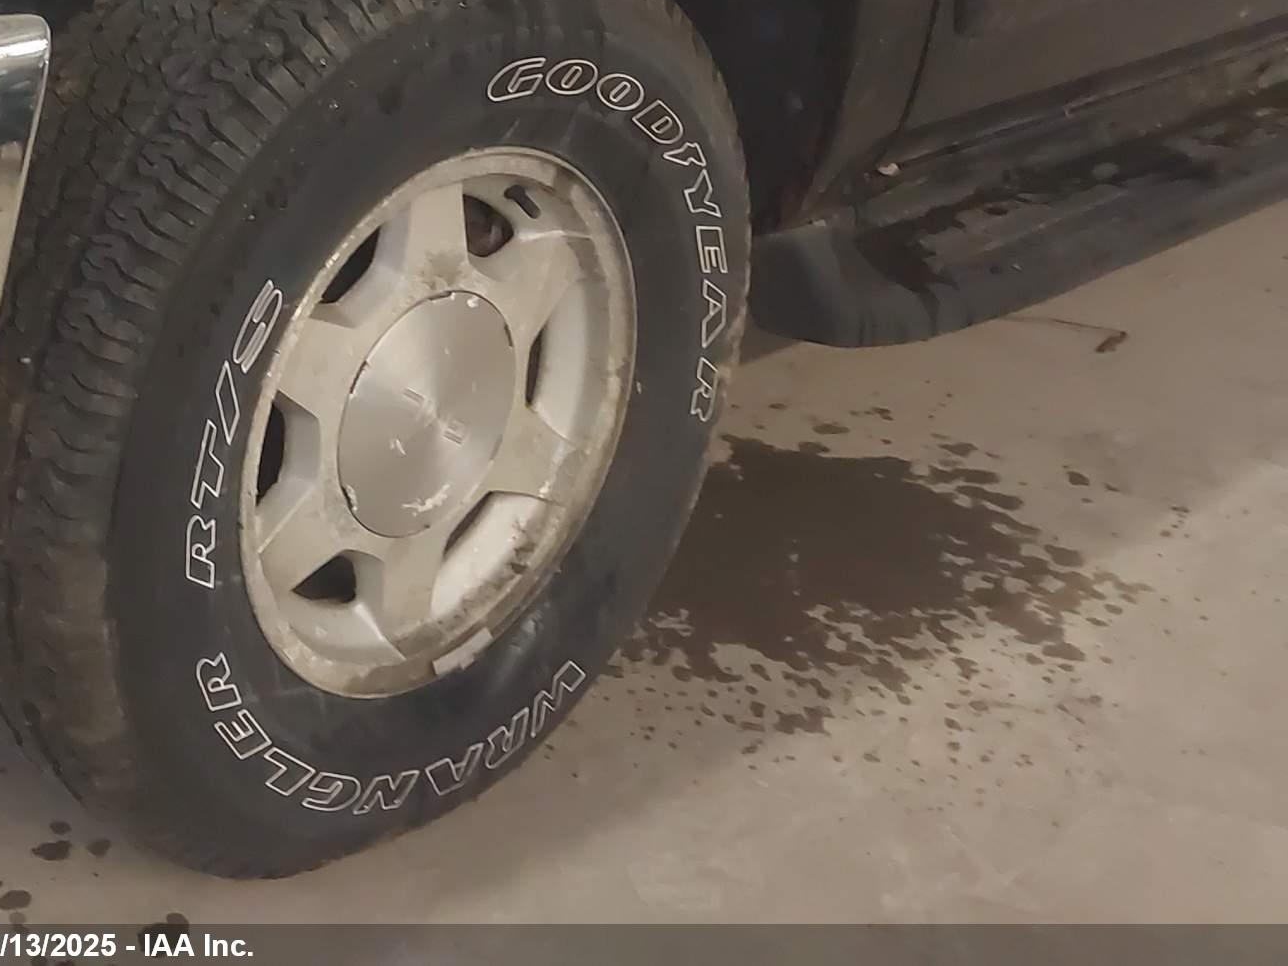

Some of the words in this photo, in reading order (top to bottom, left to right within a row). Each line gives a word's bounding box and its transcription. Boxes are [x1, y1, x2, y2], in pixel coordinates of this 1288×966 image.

[487, 57, 728, 422] GOODYEAR
[185, 278, 283, 589] RT/S
[196, 651, 587, 815] WRANGLER
